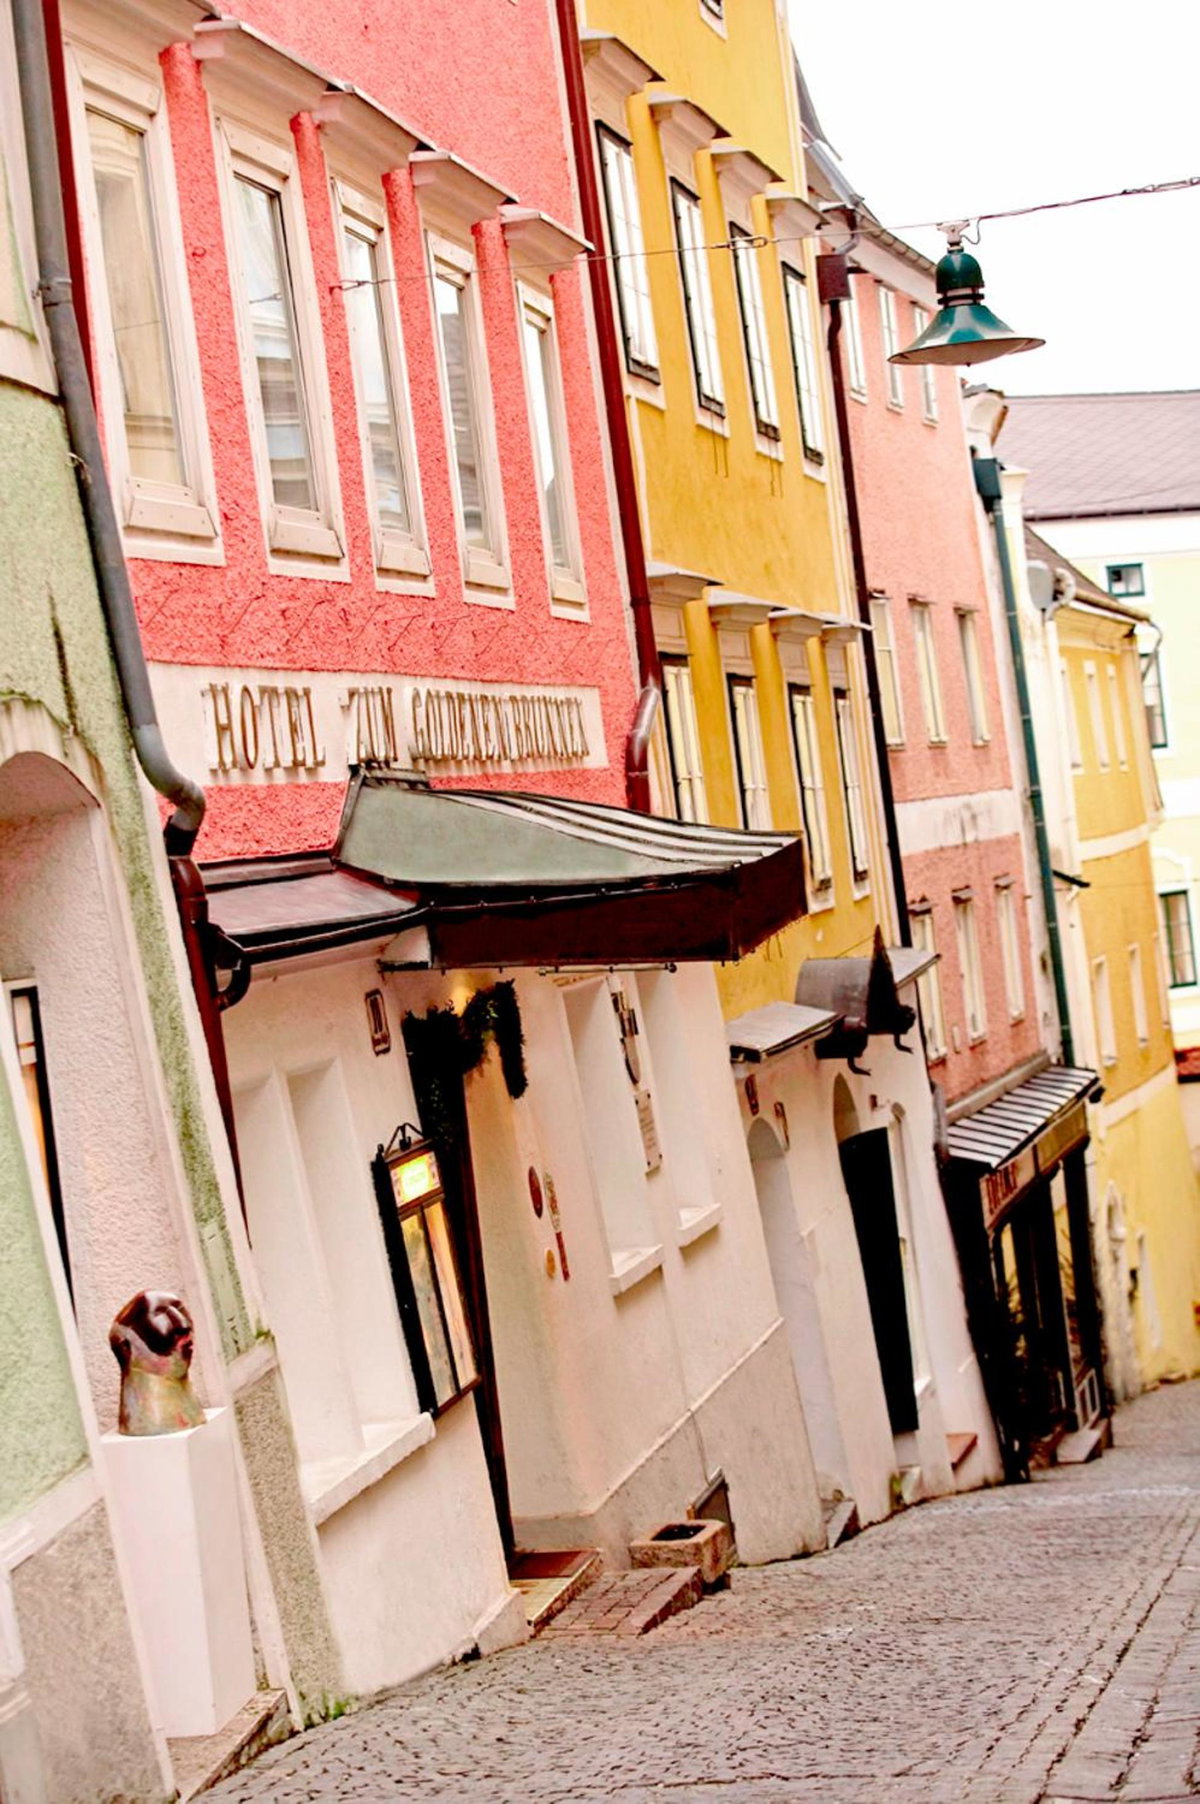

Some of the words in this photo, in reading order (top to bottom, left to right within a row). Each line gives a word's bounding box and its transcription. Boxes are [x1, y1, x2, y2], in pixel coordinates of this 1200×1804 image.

[203, 682, 326, 771] HOTEL
[340, 686, 399, 763] ZUM
[408, 687, 513, 761] GOLDENEN
[508, 696, 590, 760] BRUNNEN
